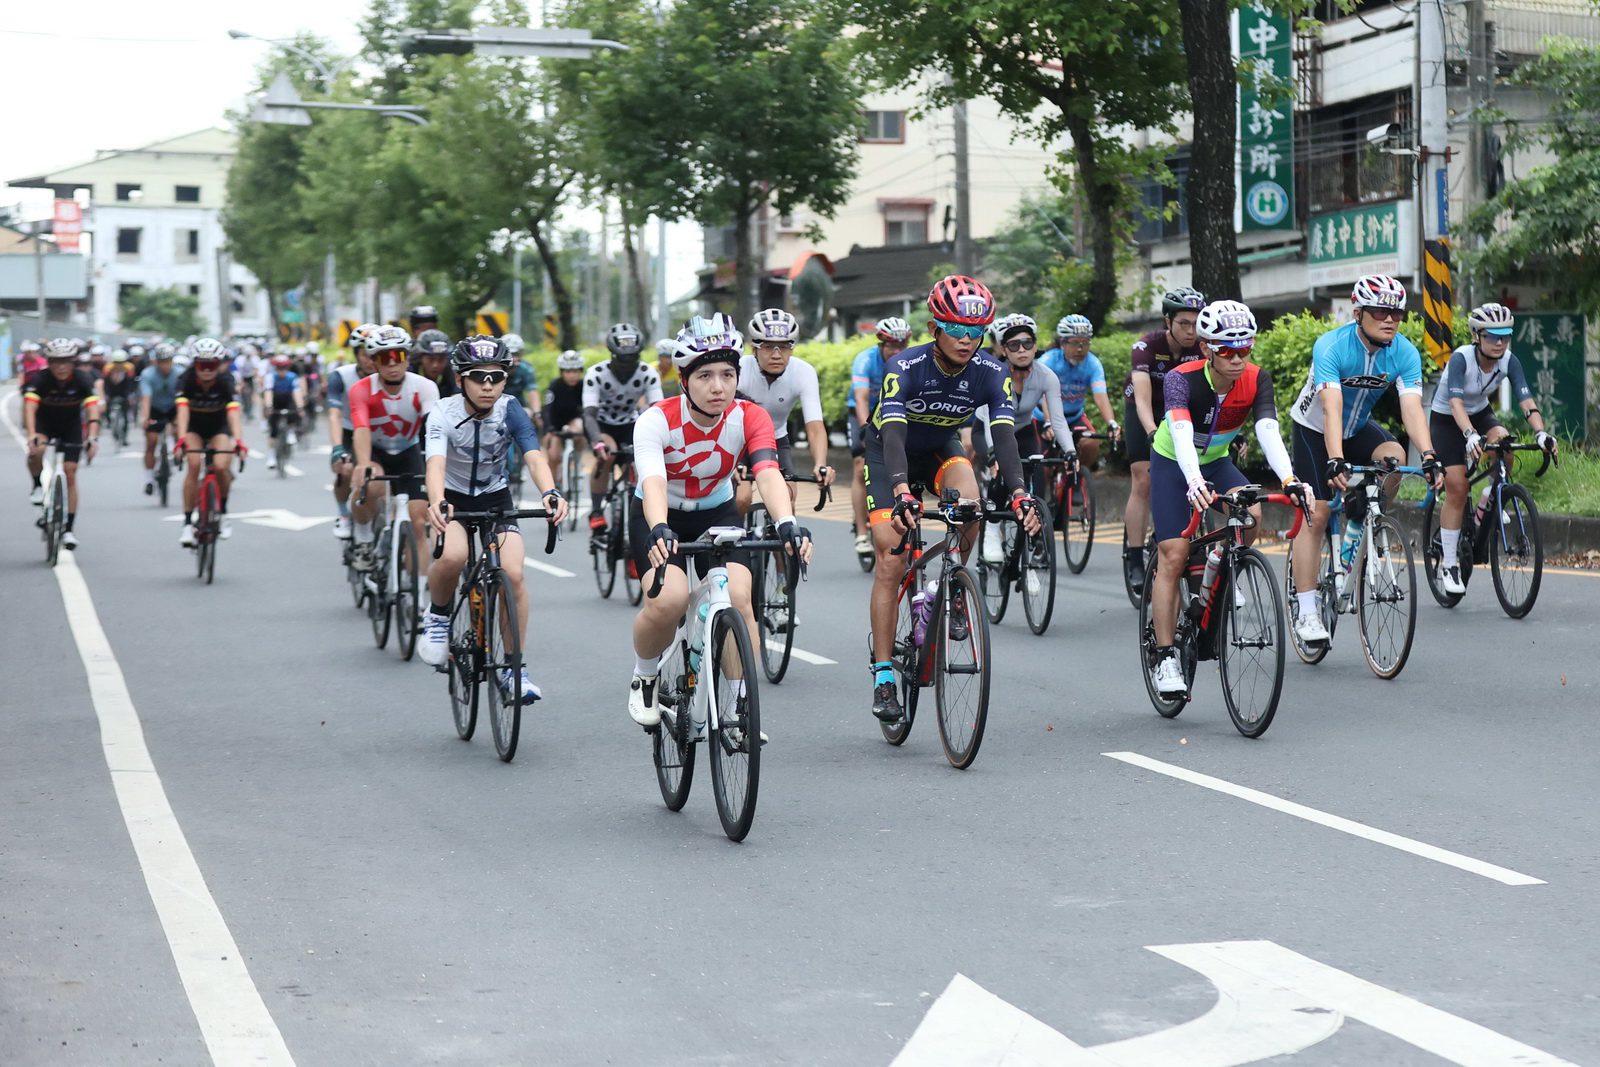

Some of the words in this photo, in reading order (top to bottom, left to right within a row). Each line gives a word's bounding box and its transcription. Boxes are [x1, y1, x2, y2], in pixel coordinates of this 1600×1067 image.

[964, 302, 984, 316] 160
[909, 353, 928, 366] ORICA
[981, 359, 1002, 372] ORICA
